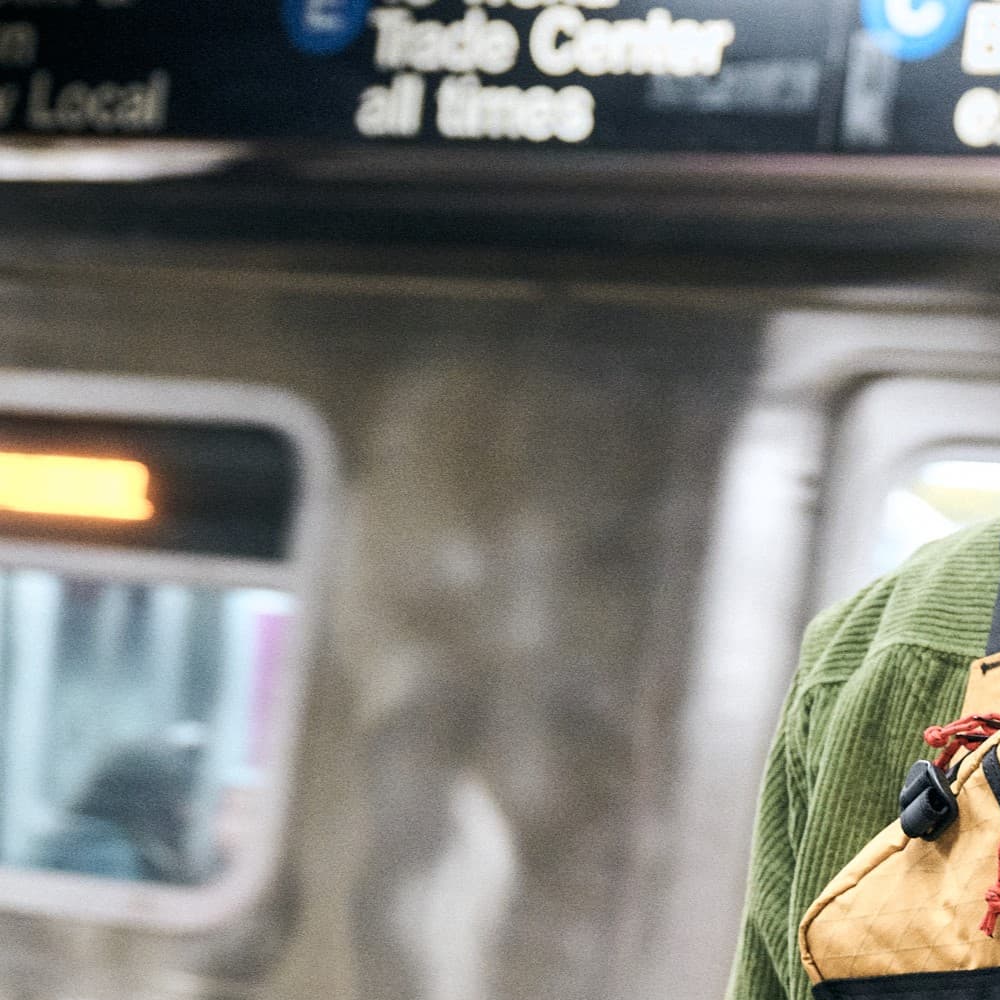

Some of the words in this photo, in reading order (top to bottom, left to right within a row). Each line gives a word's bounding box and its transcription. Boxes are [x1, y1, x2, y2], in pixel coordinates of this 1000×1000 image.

[367, 7, 519, 74] Trade
[529, 5, 735, 77] Center
[27, 68, 170, 129] Local
[355, 73, 424, 137] all
[436, 74, 596, 142] times
